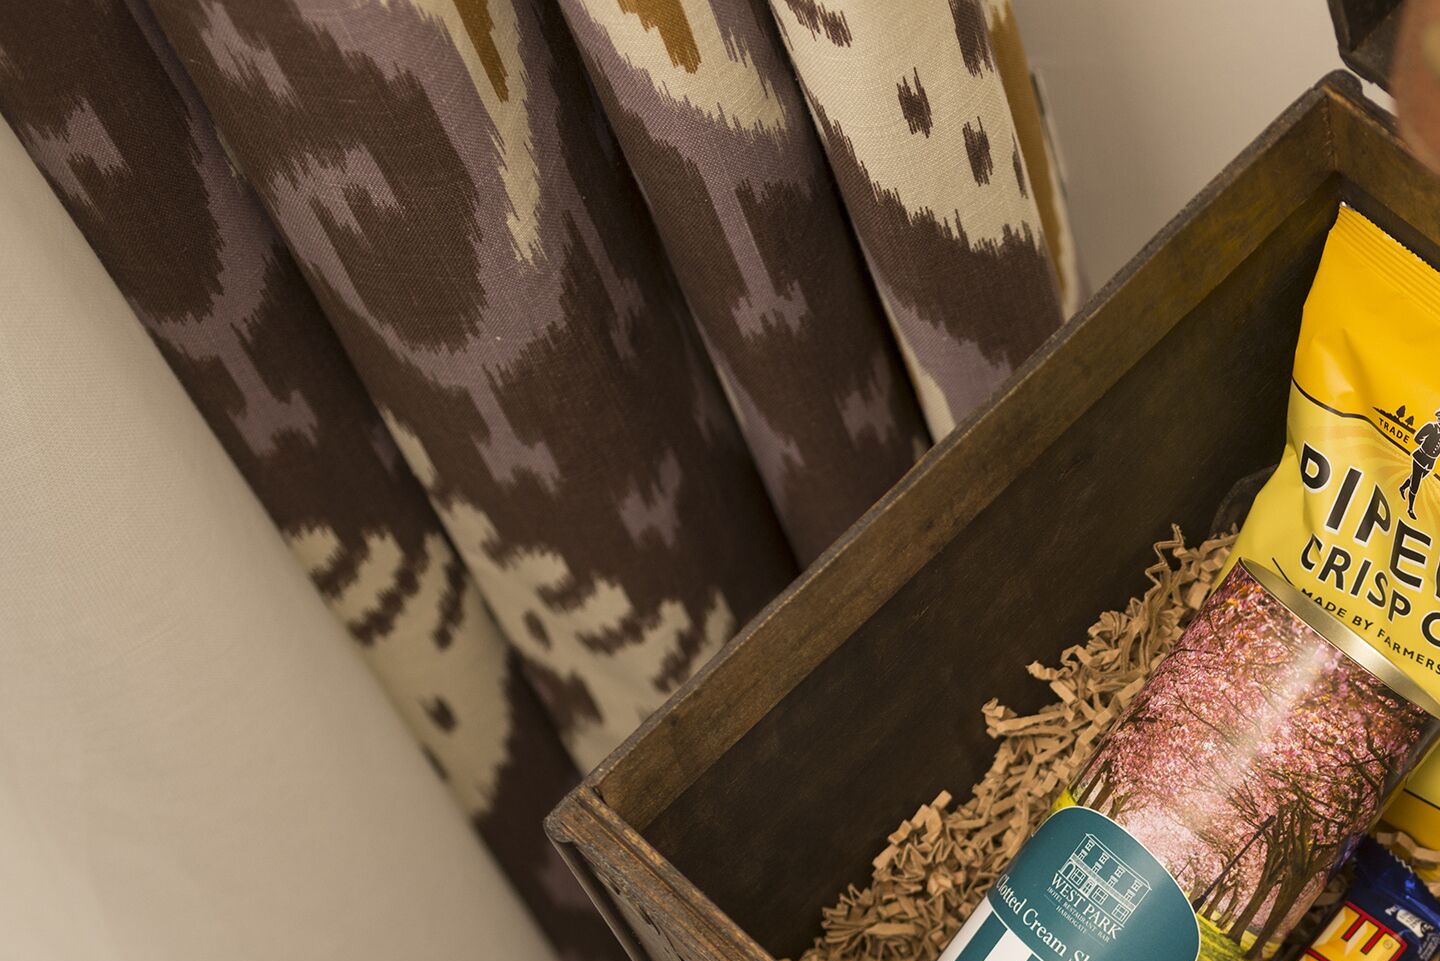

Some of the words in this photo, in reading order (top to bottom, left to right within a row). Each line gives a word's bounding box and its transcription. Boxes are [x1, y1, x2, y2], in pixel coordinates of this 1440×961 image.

[1378, 417, 1410, 444] TRADE
[1300, 533, 1412, 622] CRISP
[1301, 587, 1348, 619] MADE
[1351, 614, 1375, 631] BY
[1046, 886, 1063, 903] HOTEL
[1051, 872, 1086, 908] WEST
[1083, 903, 1123, 940] PARK
[1022, 907, 1068, 958] Cream
